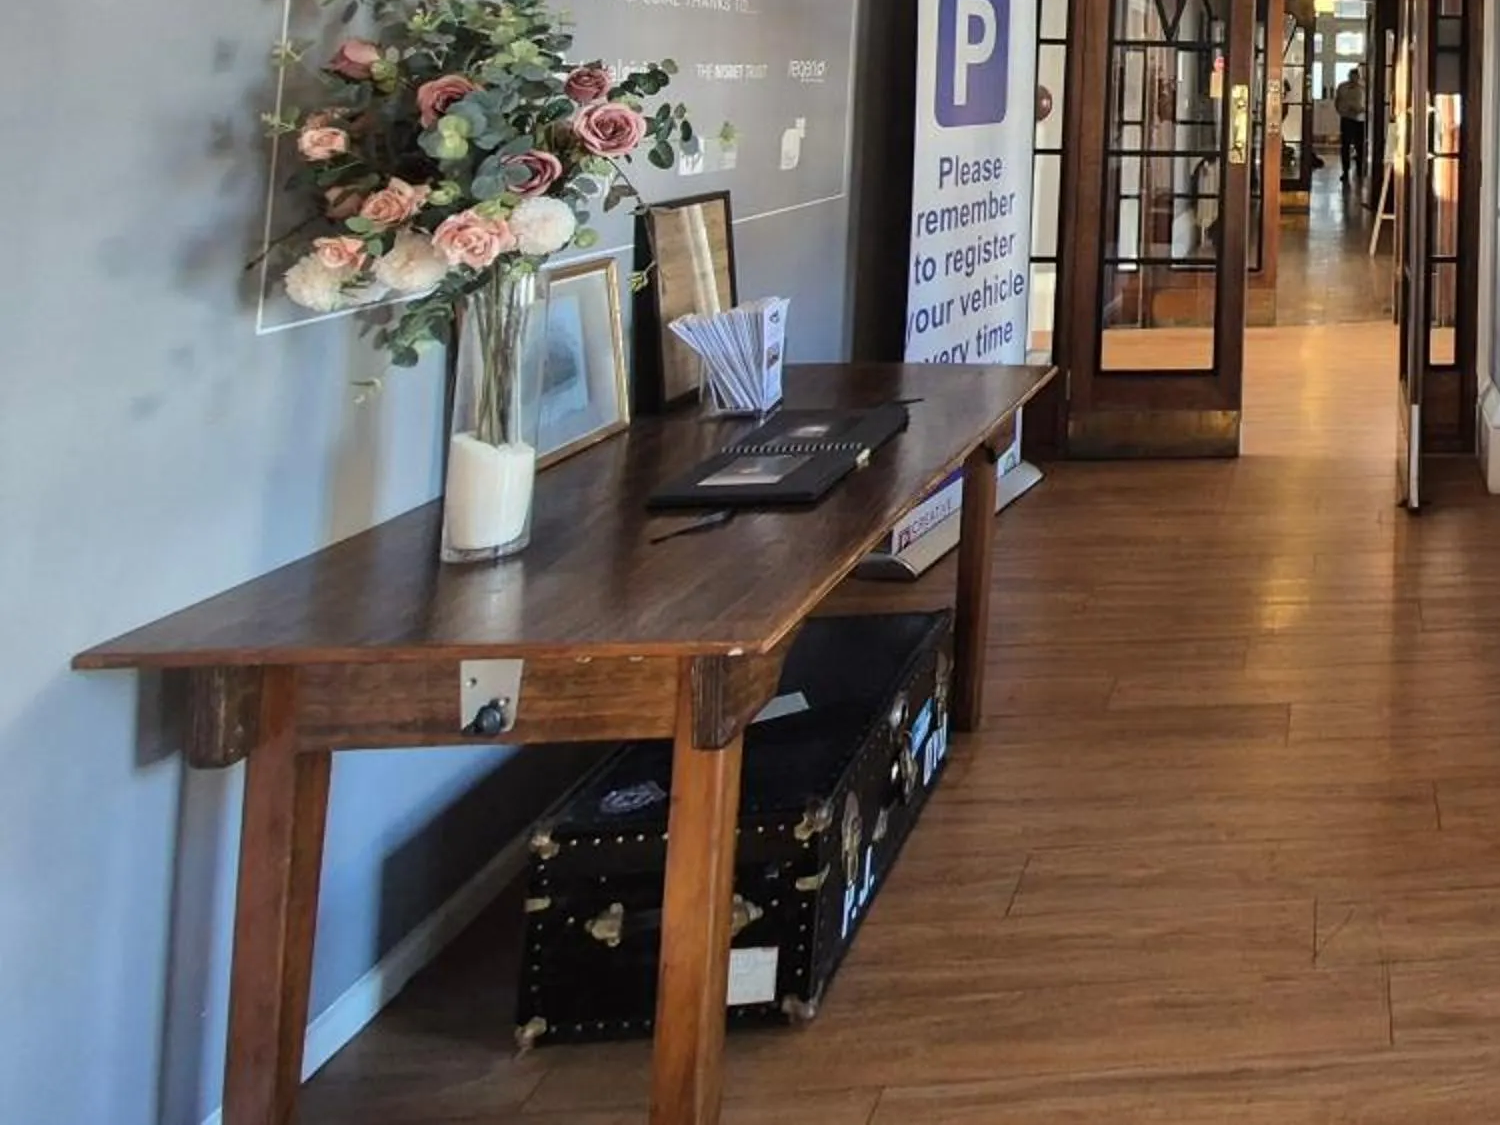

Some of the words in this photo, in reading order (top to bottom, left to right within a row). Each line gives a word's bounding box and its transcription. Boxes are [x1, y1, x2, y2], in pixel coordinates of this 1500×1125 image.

[939, 155, 1002, 189] Please
[916, 190, 1016, 237] remember
[914, 253, 937, 284] to
[945, 232, 1016, 277] register
[960, 269, 1024, 316] vehicle
[976, 321, 1013, 358] time
